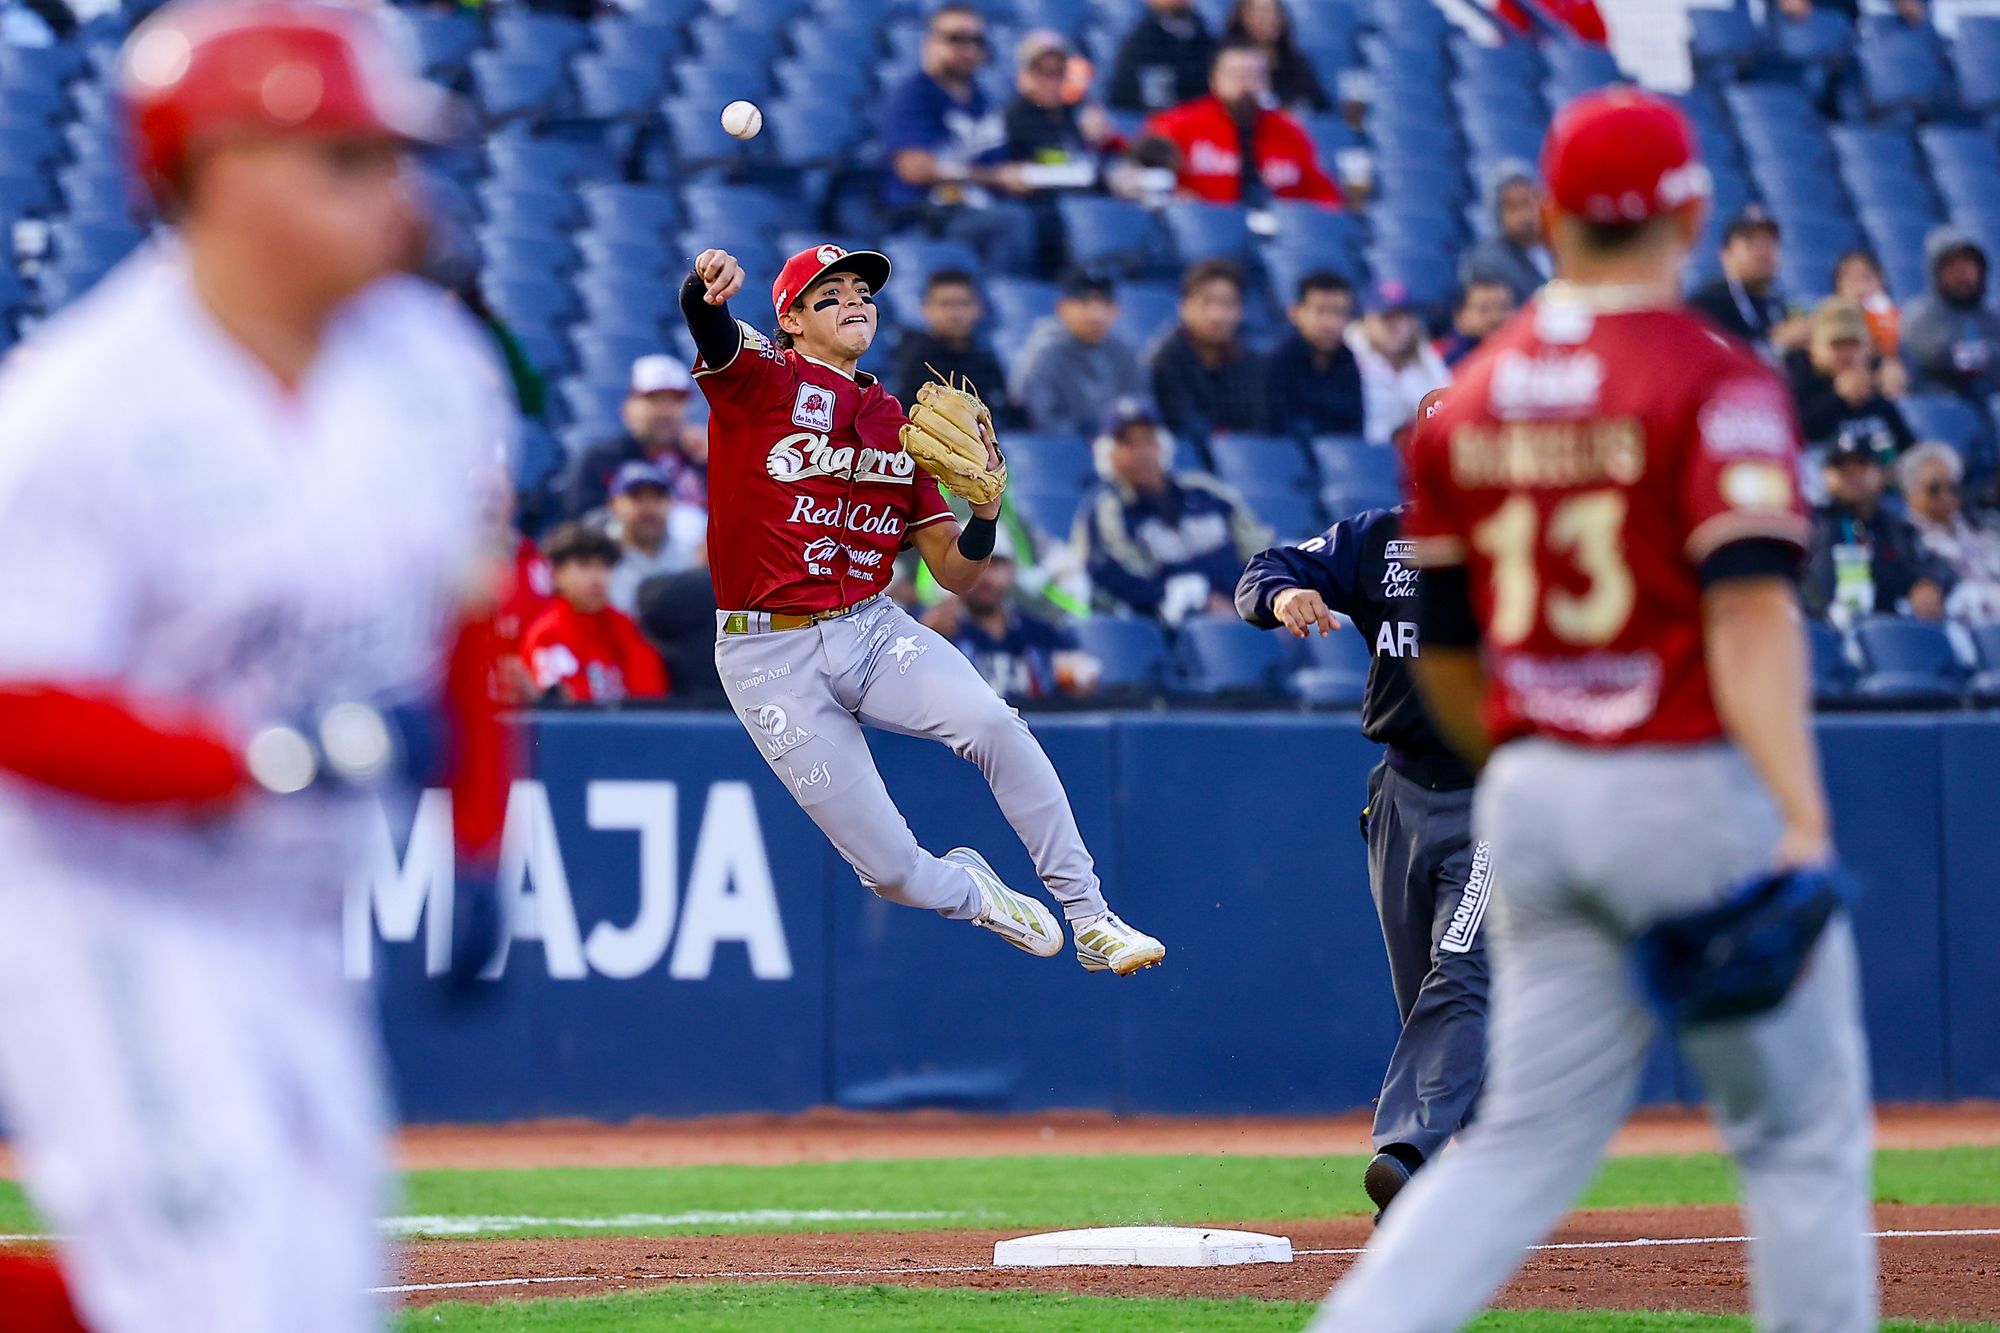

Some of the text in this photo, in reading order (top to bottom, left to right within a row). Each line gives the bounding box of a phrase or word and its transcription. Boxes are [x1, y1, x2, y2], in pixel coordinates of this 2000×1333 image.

[812, 418, 829, 428] Rosa
[787, 495, 901, 535] Red Cola
[1381, 562, 1420, 584] Red
[1474, 490, 1637, 647] 13
[1385, 582, 1416, 597] Cola
[735, 663, 791, 692] Campo Azul
[788, 760, 831, 798] Inés
[342, 779, 793, 981] MAJA
